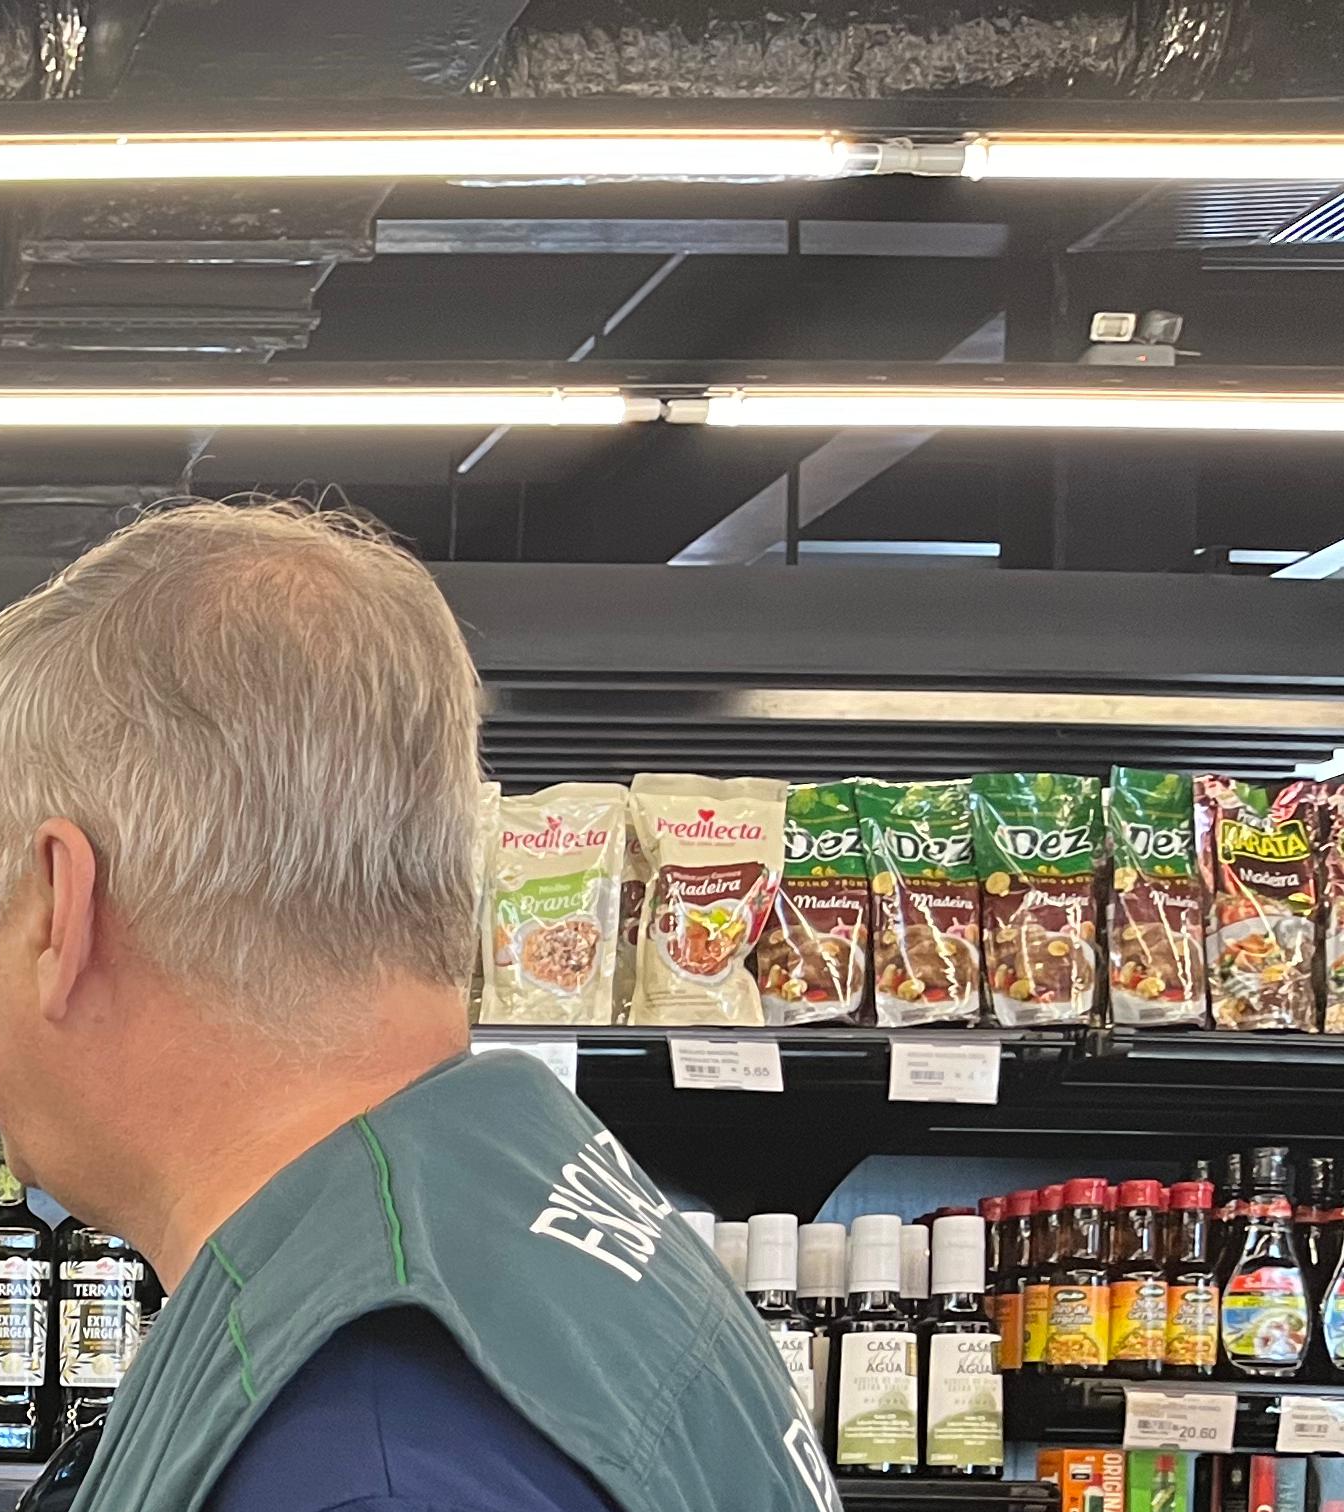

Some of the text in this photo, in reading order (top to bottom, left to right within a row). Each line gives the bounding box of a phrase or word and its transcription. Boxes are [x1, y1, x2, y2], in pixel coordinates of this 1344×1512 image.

[657, 818, 762, 841] Predilecta
[502, 828, 607, 849] Predilecta
[1004, 825, 1092, 860] Dez
[894, 831, 974, 866] Dez
[669, 879, 741, 898] Madeira
[793, 894, 862, 910] Madeira
[87, 1315, 118, 1327] EXTRA
[83, 1327, 123, 1339] VIRGEM
[867, 1341, 901, 1352] CASA
[866, 1362, 902, 1373] AGUA
